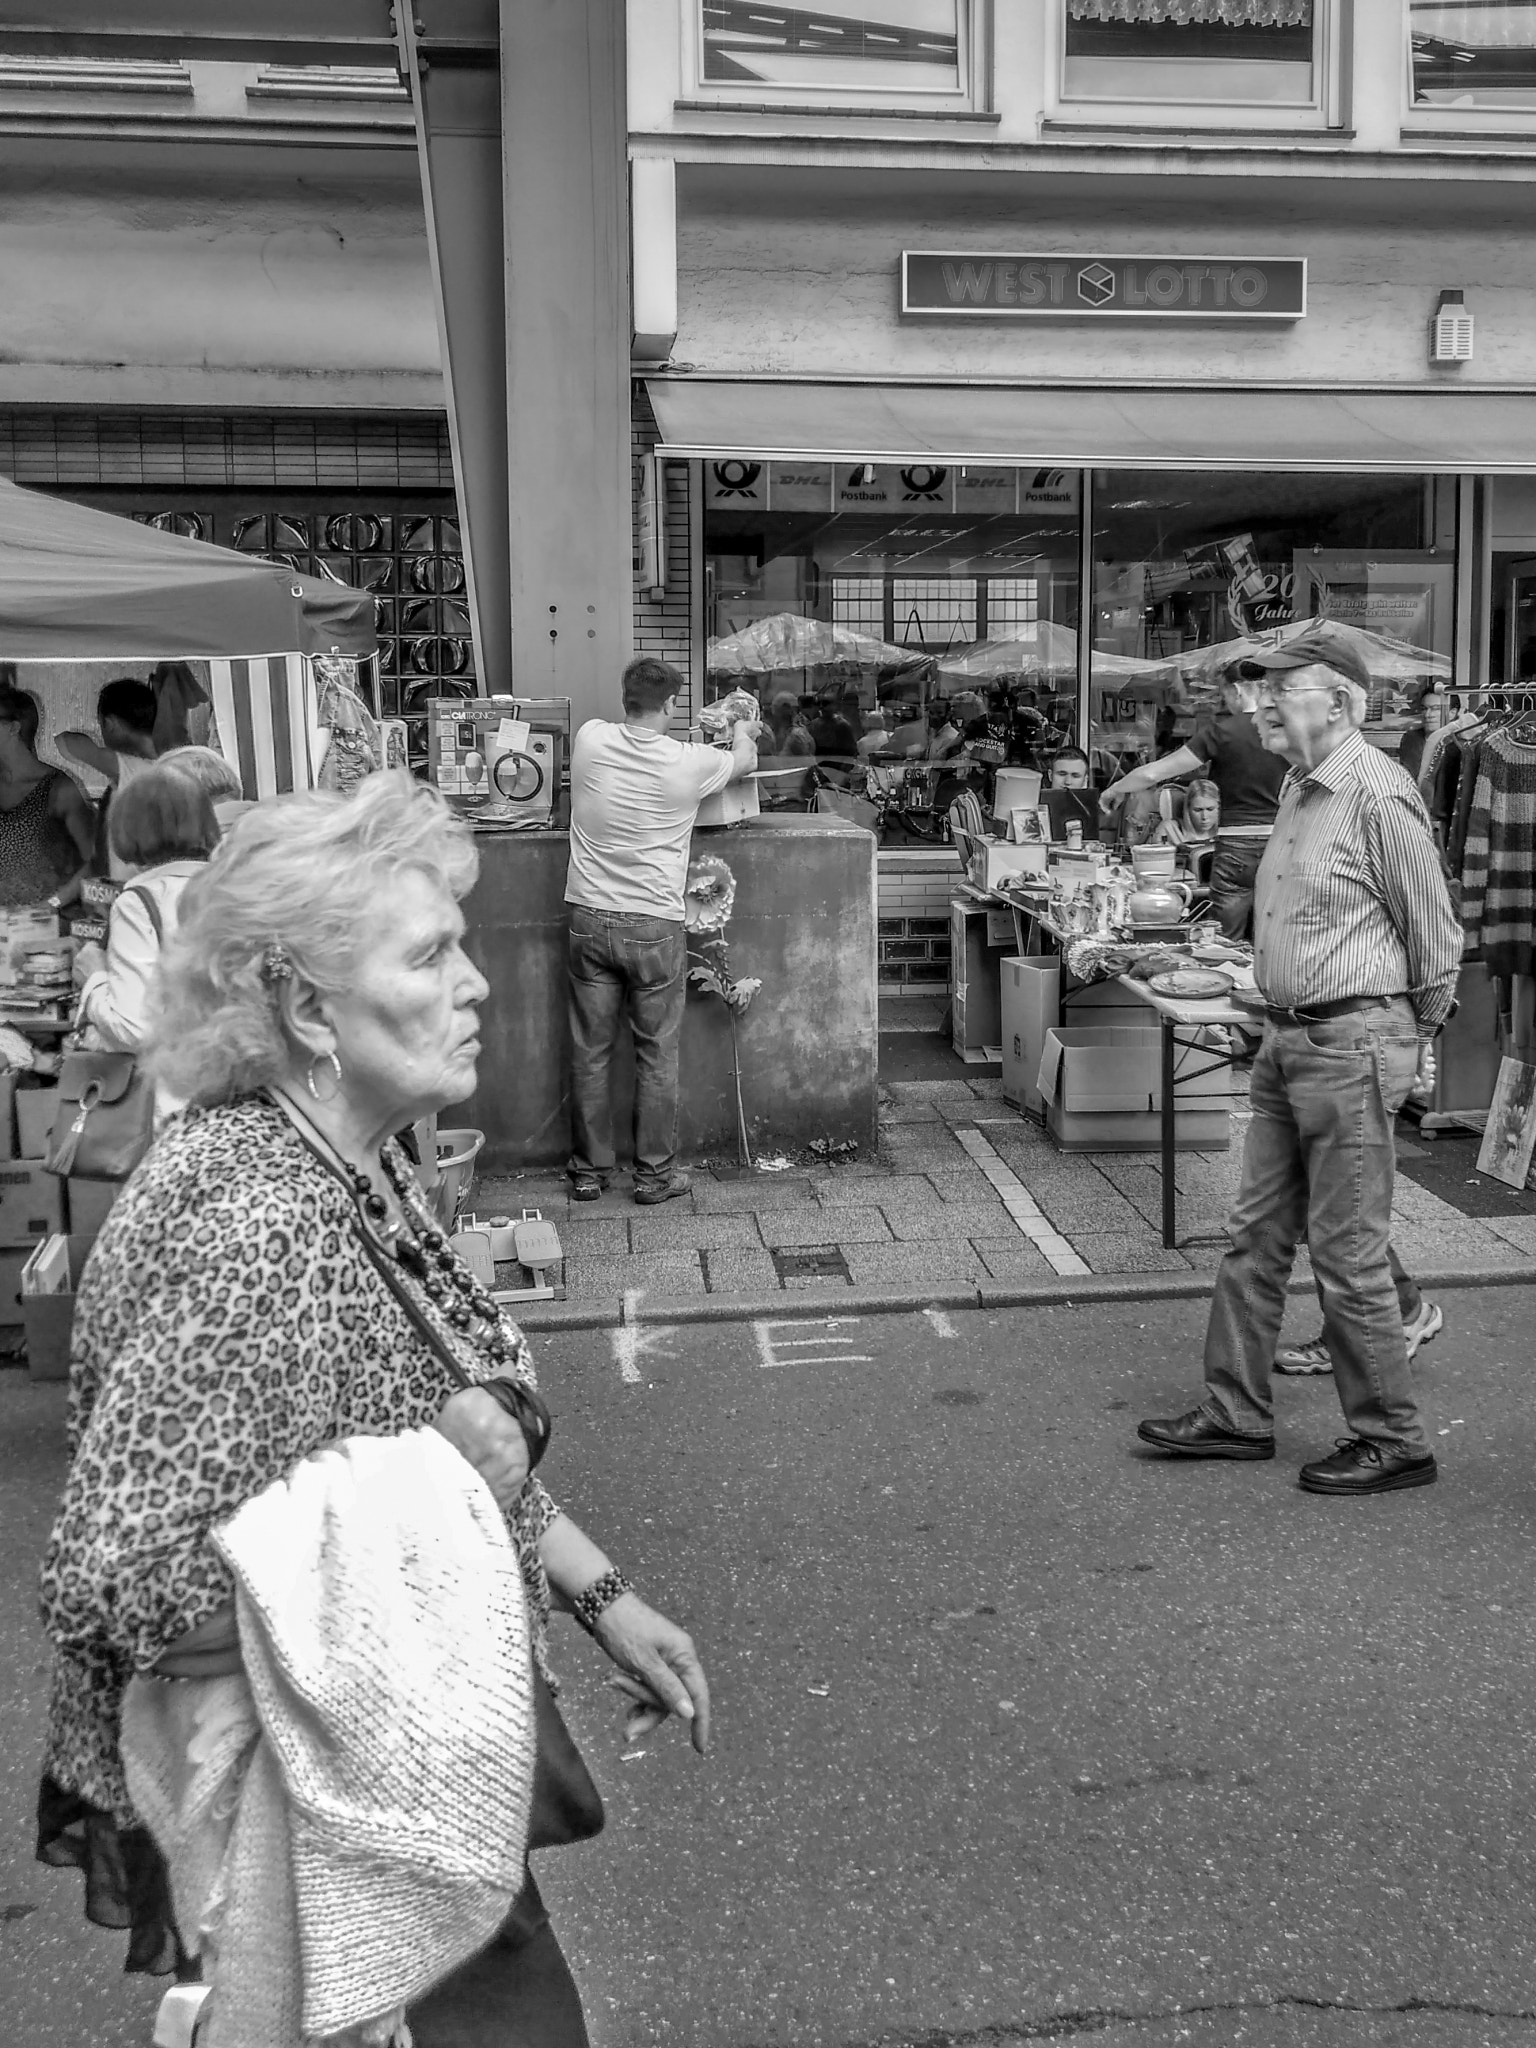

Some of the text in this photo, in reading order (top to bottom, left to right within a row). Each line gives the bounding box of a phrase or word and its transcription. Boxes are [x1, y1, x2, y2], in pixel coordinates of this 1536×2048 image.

[941, 262, 1268, 307] WEST LOTTO
[779, 475, 823, 486] DHL
[964, 477, 1009, 488] DHL
[840, 490, 887, 501] Postbank
[1025, 491, 1072, 502] Postbank
[1246, 573, 1300, 602] 20
[1254, 603, 1302, 622] Jahre
[71, 922, 106, 939] KOSMO
